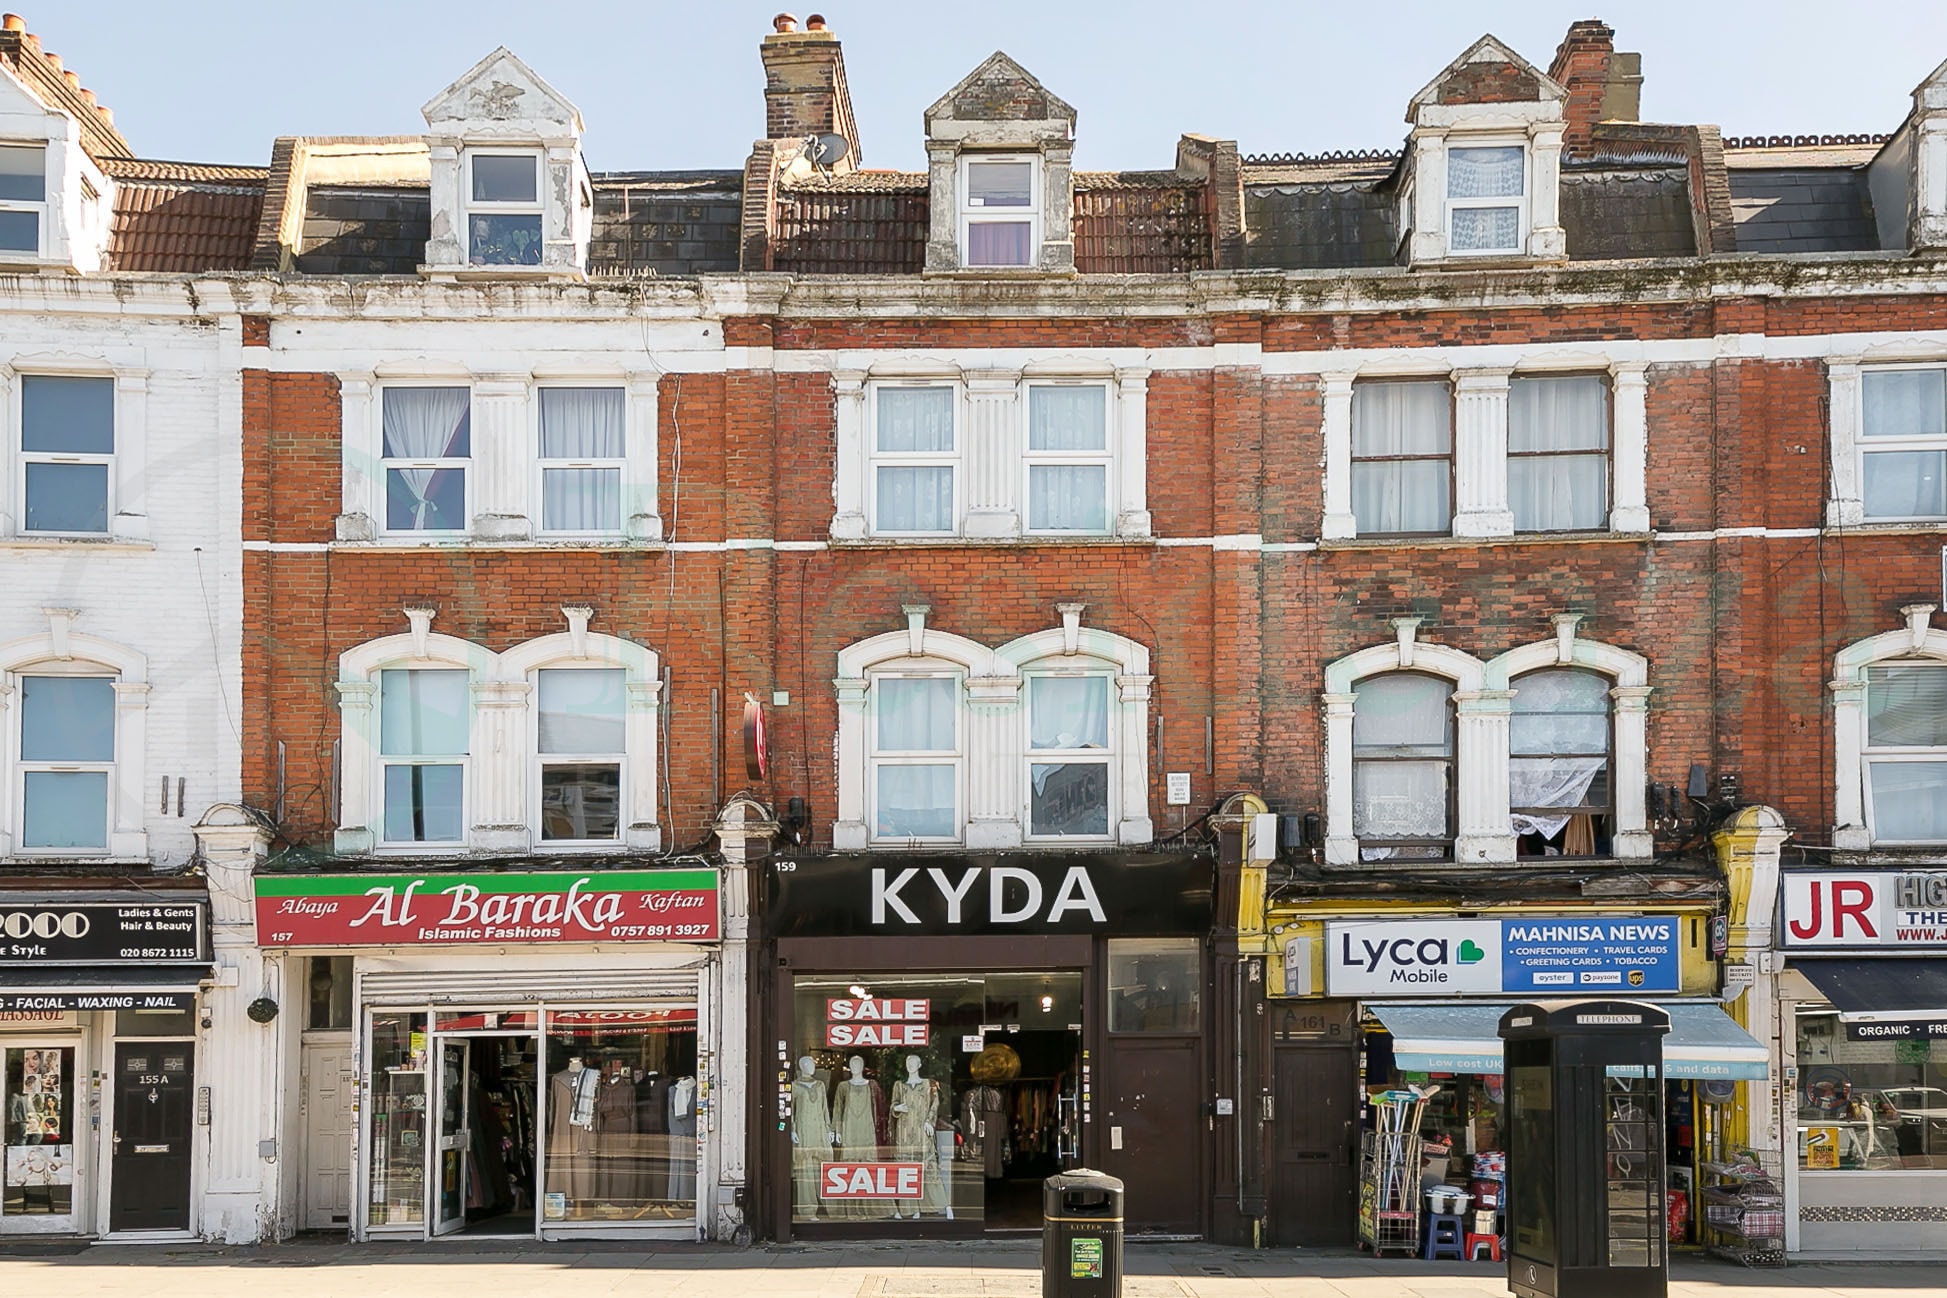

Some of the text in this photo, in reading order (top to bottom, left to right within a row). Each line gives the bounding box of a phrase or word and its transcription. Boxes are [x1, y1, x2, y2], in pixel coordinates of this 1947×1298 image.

[774, 862, 796, 871] 159
[871, 866, 1108, 924] KYDA
[1895, 875, 1947, 909] HIG
[349, 877, 625, 932] Al Baraka
[639, 891, 706, 912] Kaftan
[118, 908, 194, 917] Ladies & Gents
[276, 897, 339, 919] Abaya
[1789, 880, 1879, 940] JR
[120, 921, 192, 932] Hair & Beauty
[611, 924, 710, 937] 0757 891 3927
[271, 932, 293, 941] 157
[419, 926, 561, 940] Islamic Fashions
[1508, 925, 1670, 942] MAHNISA NEWS
[120, 948, 194, 957] 020 8672 1115
[1343, 933, 1448, 973] Lyca
[1516, 946, 1668, 955] CONFECTIONERY TRAVEL CARDS
[1526, 957, 1658, 966] GREETING CARDS TOBACCO
[1390, 969, 1448, 983] Mobile
[1539, 973, 1566, 982] oyster
[1592, 974, 1619, 982] payzone
[1629, 974, 1643, 984] ups
[16, 997, 66, 1009] FACIAL
[78, 997, 133, 1008] WAXING
[144, 997, 177, 1007] NAIL
[830, 1000, 927, 1020] SALE
[1285, 1009, 1297, 1021] A
[1302, 1016, 1325, 1029] 161
[1580, 1015, 1637, 1023] TELEPHONE
[830, 1025, 927, 1045] SALE
[1330, 1024, 1341, 1036] B
[1858, 1025, 1910, 1036] ORGANIC
[1428, 1058, 1503, 1069] Low cost UK
[1676, 1064, 1699, 1074] and
[1702, 1064, 1729, 1075] data
[139, 1075, 169, 1084] 155 A
[826, 1167, 918, 1194] SALE
